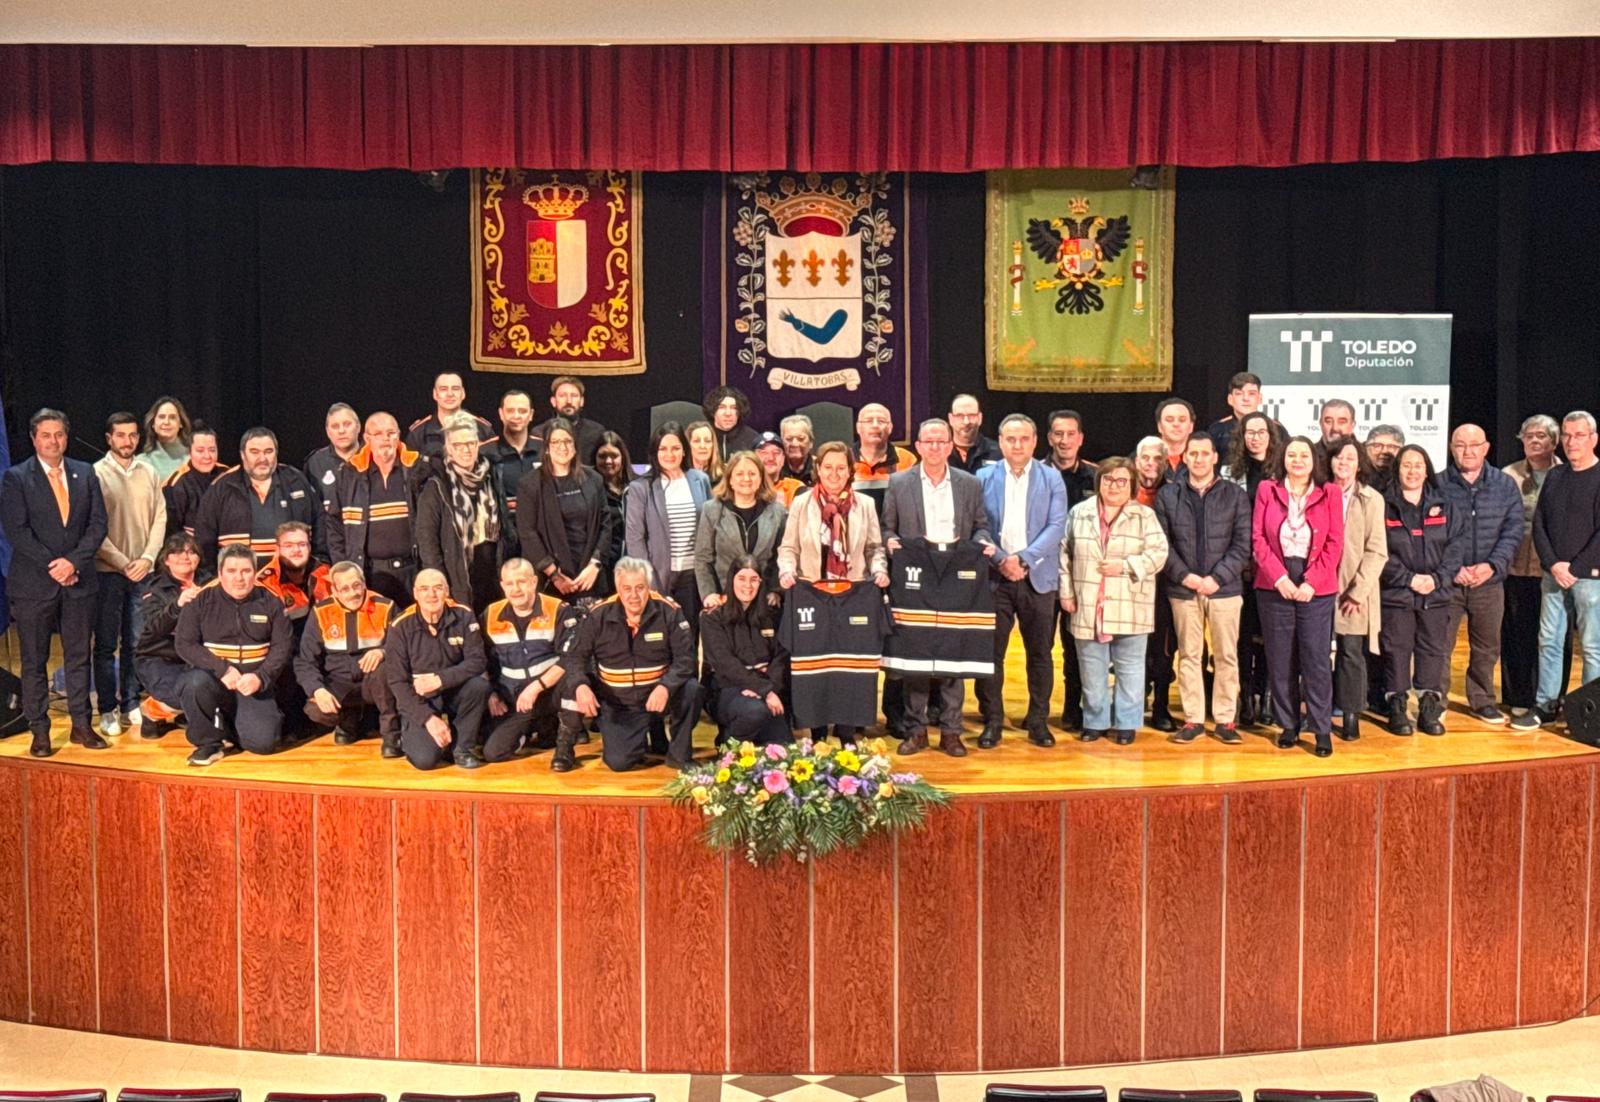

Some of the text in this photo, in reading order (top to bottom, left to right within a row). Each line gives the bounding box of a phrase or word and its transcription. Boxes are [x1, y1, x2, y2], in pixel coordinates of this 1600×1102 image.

[1341, 340, 1417, 355] TOLEDO
[1345, 356, 1414, 369] Diputación
[783, 371, 848, 387] VILLATOBAS
